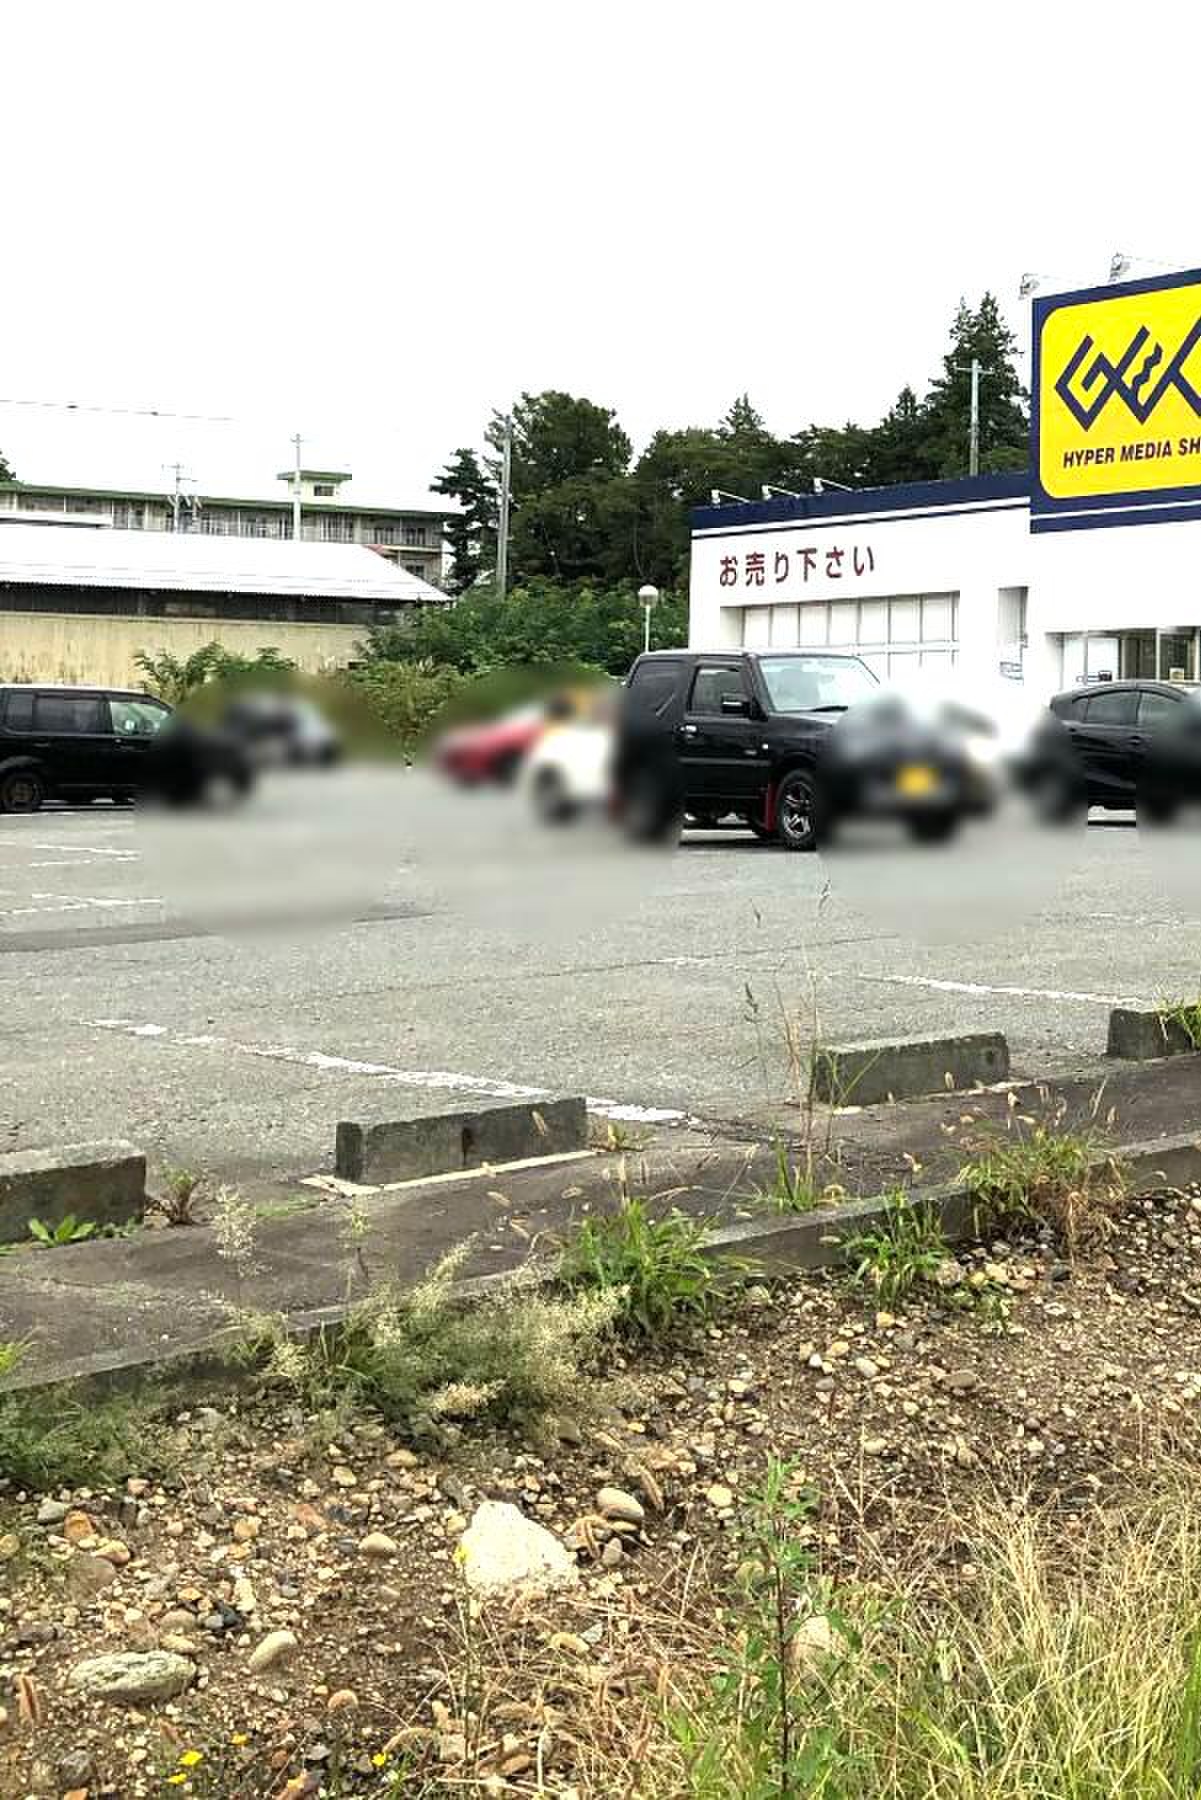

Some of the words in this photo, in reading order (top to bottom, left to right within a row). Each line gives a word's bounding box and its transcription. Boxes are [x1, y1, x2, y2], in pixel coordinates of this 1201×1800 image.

[1063, 447, 1115, 468] HYPER
[1120, 440, 1173, 462] MEDIA
[719, 545, 875, 587] お売り下さい
